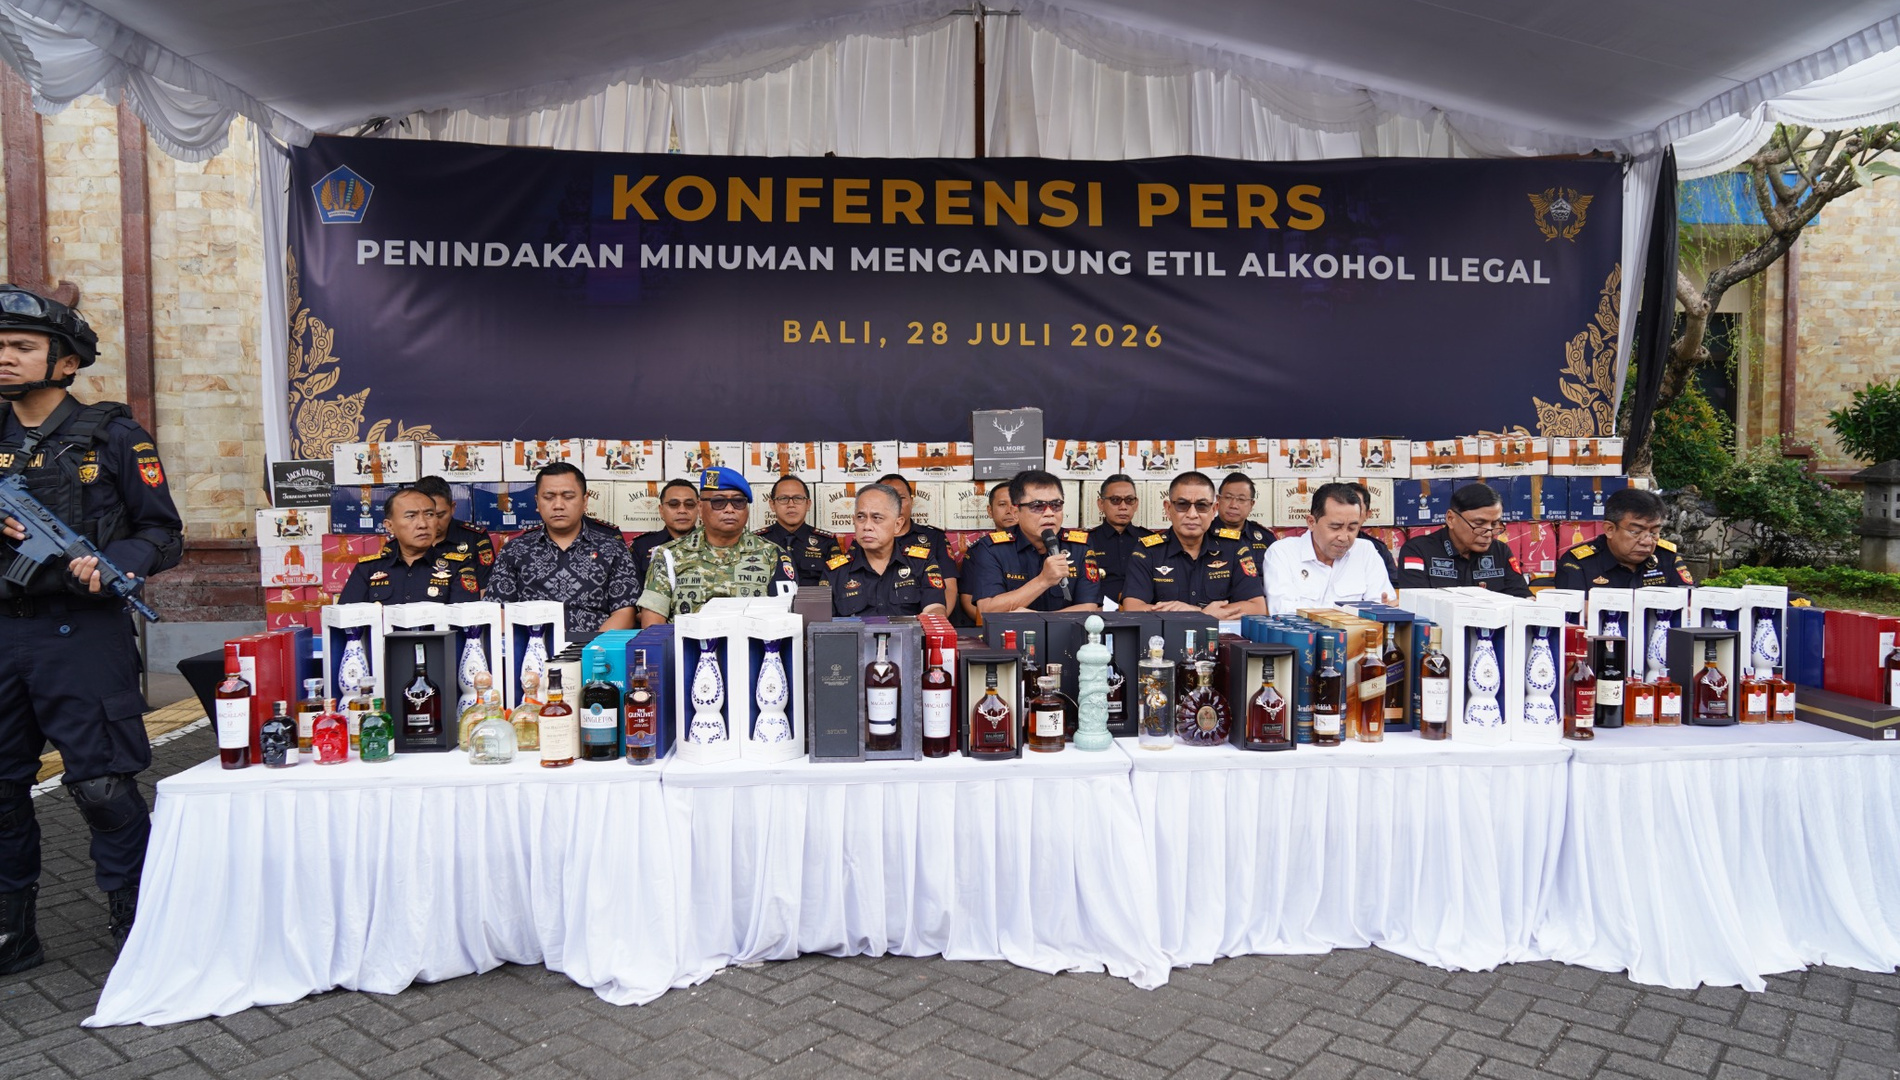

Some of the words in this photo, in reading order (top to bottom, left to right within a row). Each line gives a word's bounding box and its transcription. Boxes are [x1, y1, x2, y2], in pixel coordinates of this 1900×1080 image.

[612, 174, 1103, 228] KONFERENSI
[1137, 183, 1326, 231] PERS
[356, 239, 623, 268] PENINDAKAN
[640, 244, 834, 271] MINUMAN
[850, 247, 1131, 275] MENGANDUNG
[1147, 251, 1226, 277] ETIL
[1238, 252, 1416, 281] ALKOHOL
[1429, 256, 1551, 285] ILEGAL
[783, 319, 886, 348] BALI,
[907, 321, 948, 345] 28
[967, 322, 1050, 346] JULI
[1071, 323, 1162, 348] 2026
[993, 445, 1026, 453] DALMORE
[286, 469, 302, 483] JACK
[301, 467, 326, 482] DANIEL'S
[738, 574, 753, 582] TNI
[756, 575, 768, 584] AD
